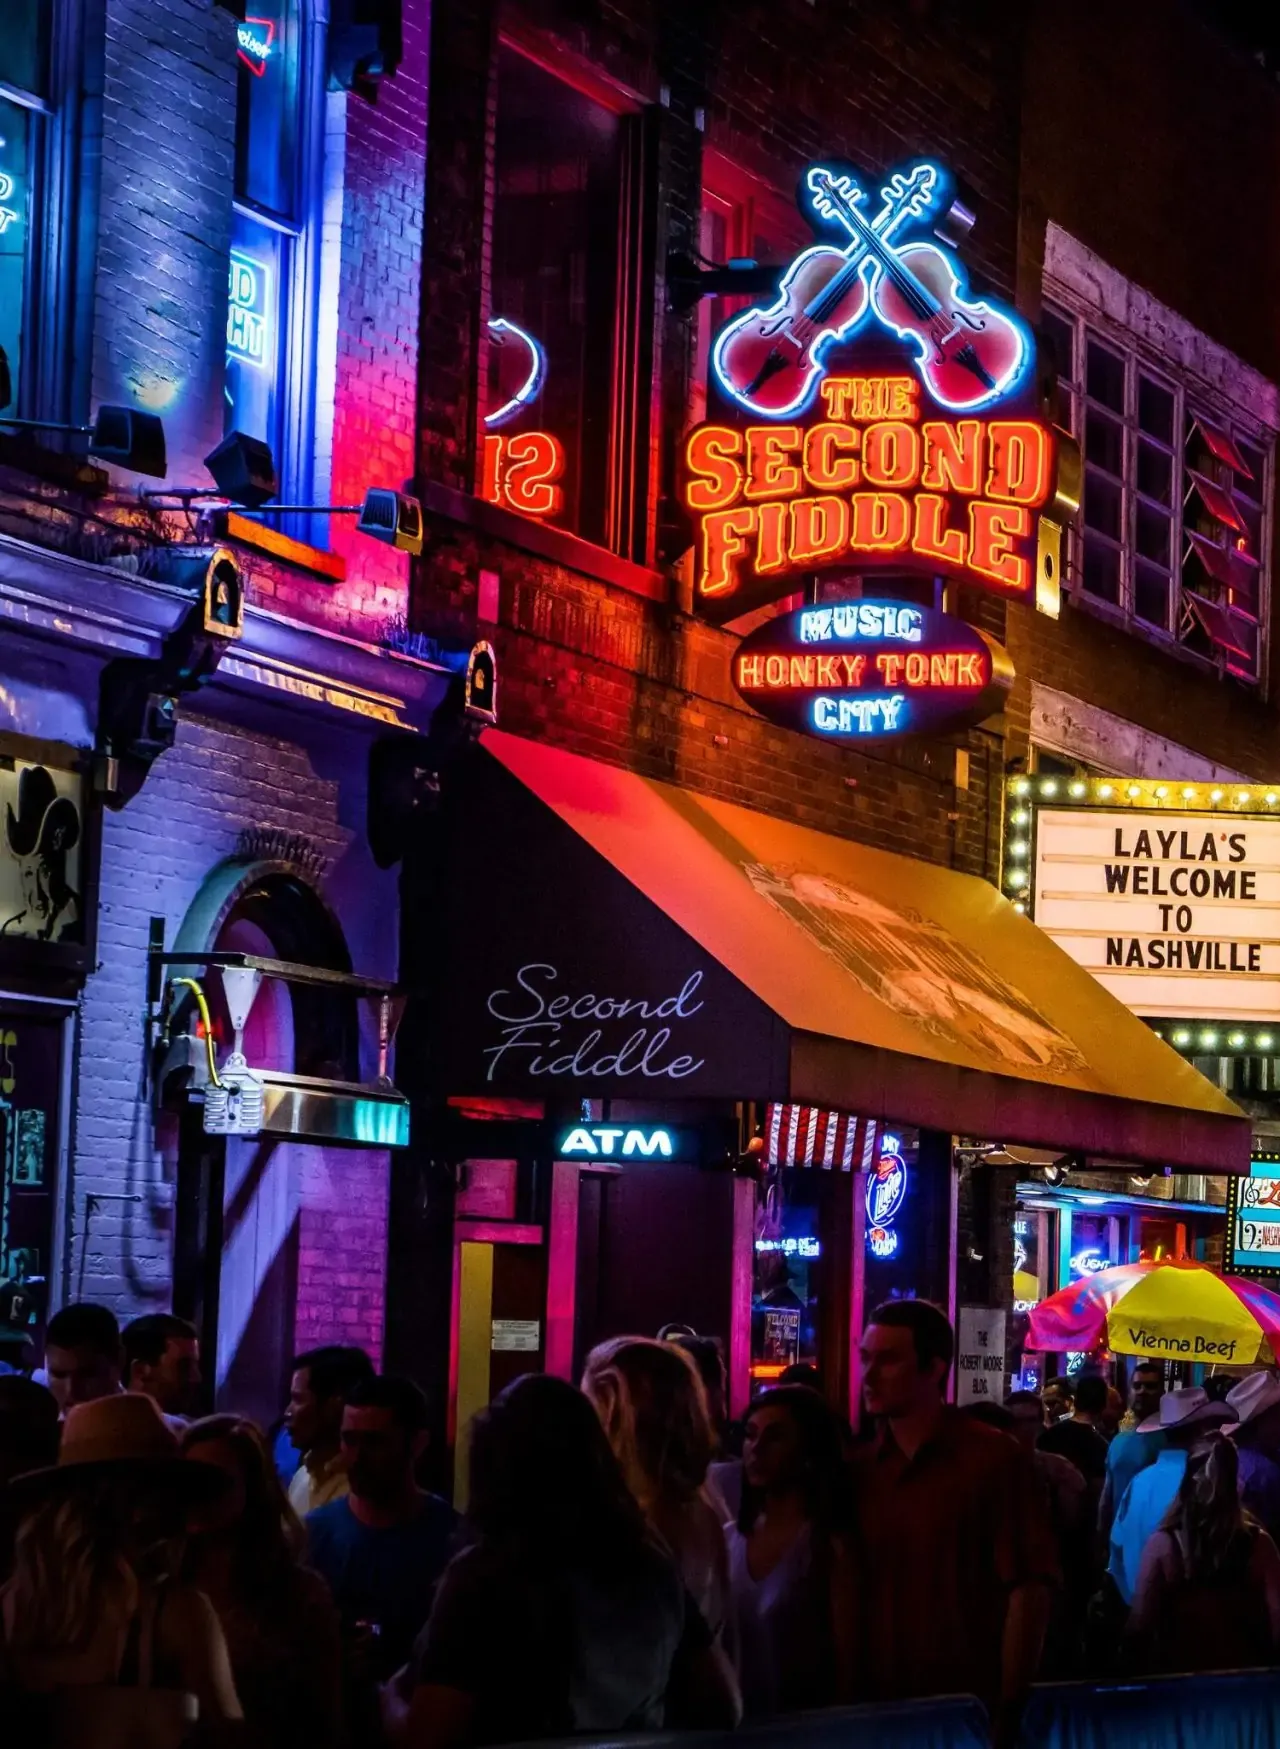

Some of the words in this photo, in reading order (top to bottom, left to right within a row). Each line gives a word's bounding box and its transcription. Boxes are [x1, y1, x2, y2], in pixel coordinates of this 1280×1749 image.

[821, 378, 917, 420] THE
[687, 421, 1053, 509] SECOND
[700, 494, 1030, 595] FIDDLE
[800, 605, 921, 643] MUSIC
[738, 653, 866, 690] HONKY
[876, 653, 983, 687] TONK
[813, 694, 904, 731] CITY
[1114, 828, 1247, 863] LAYLA'S
[1104, 864, 1257, 900] WELCOME
[1158, 903, 1193, 933] TO
[1105, 937, 1262, 972] NASHVILLE
[487, 963, 704, 1024] Second
[483, 1021, 705, 1081] Fiddle
[560, 1128, 673, 1156] ATM
[1128, 1327, 1191, 1352] Vienna
[1194, 1335, 1237, 1361] Beef
